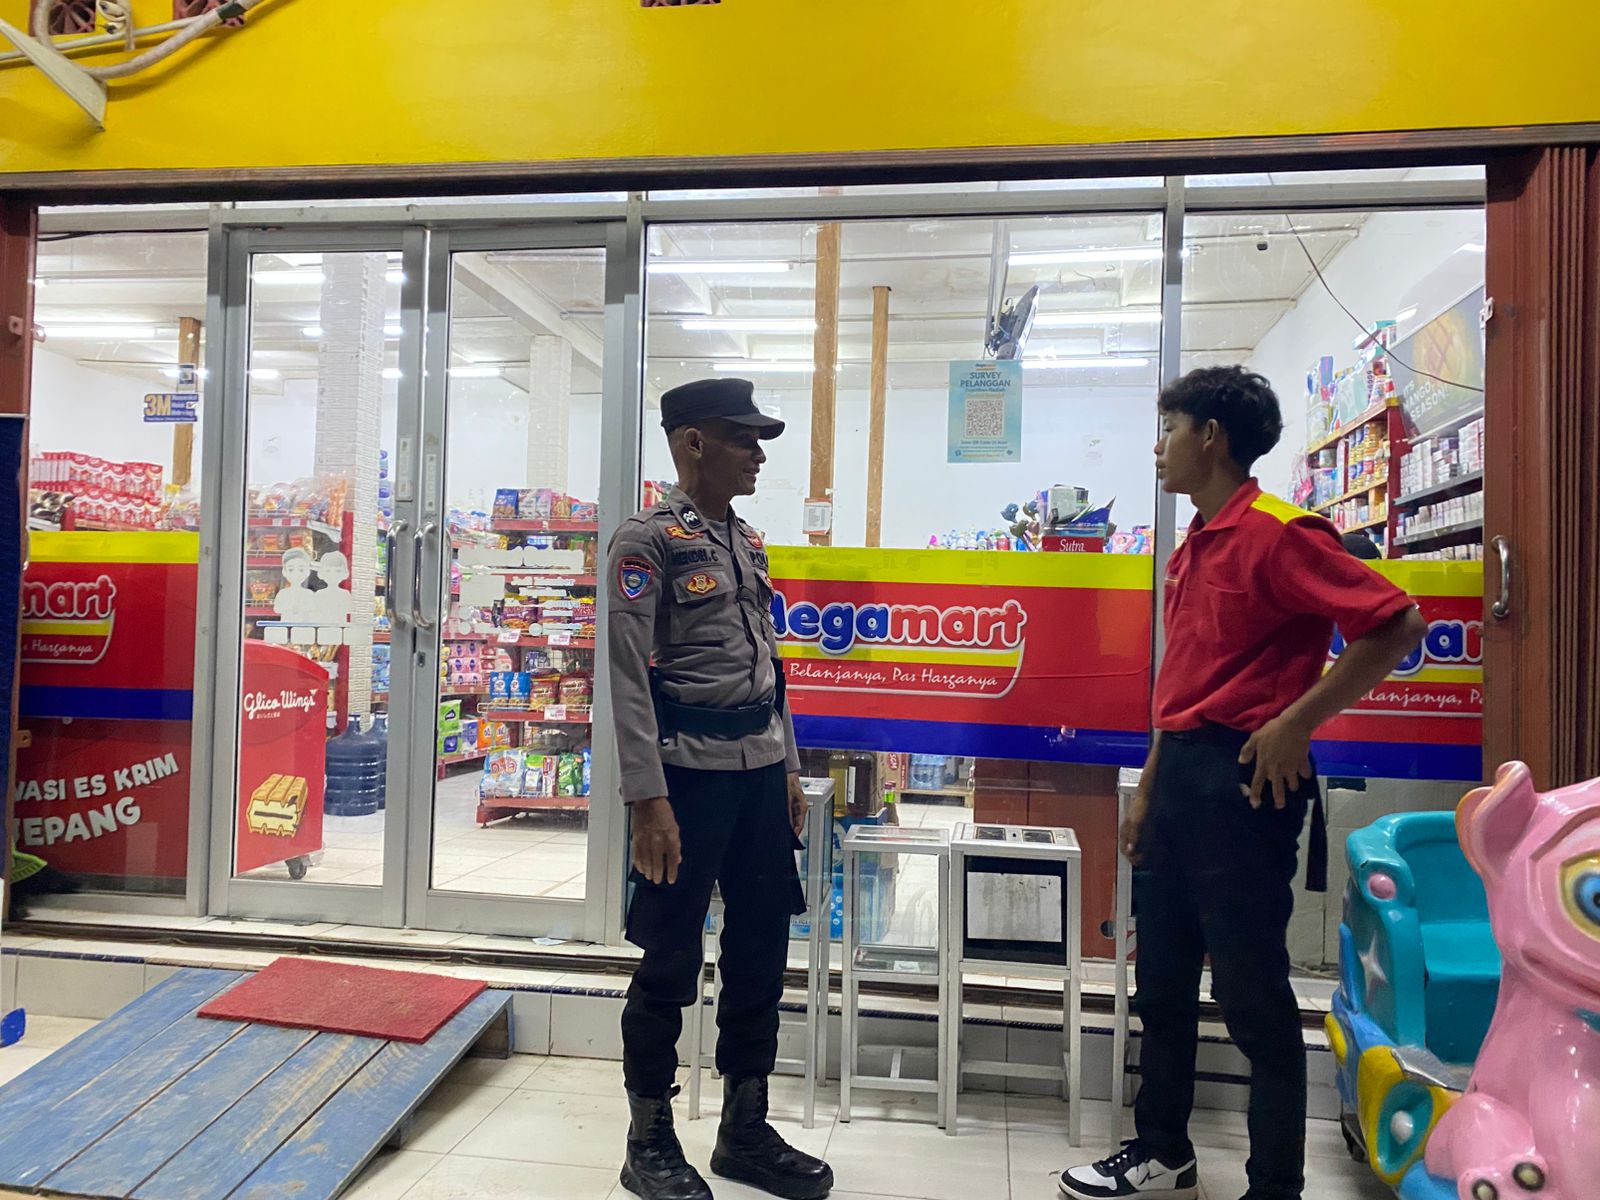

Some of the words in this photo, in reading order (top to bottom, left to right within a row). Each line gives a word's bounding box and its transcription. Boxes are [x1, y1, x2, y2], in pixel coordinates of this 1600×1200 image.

[960, 380, 1011, 388] PELANGGAN
[969, 371, 1002, 380] SURVEY
[145, 394, 171, 416] 3M
[1059, 539, 1085, 552] Sutra
[789, 663, 887, 684] Belanjanya,
[892, 668, 916, 682] Pas
[921, 668, 998, 690] Harganya
[244, 691, 281, 720] Glico
[280, 689, 318, 712] Wings
[73, 774, 107, 799] ES
[113, 752, 179, 792] KRIM
